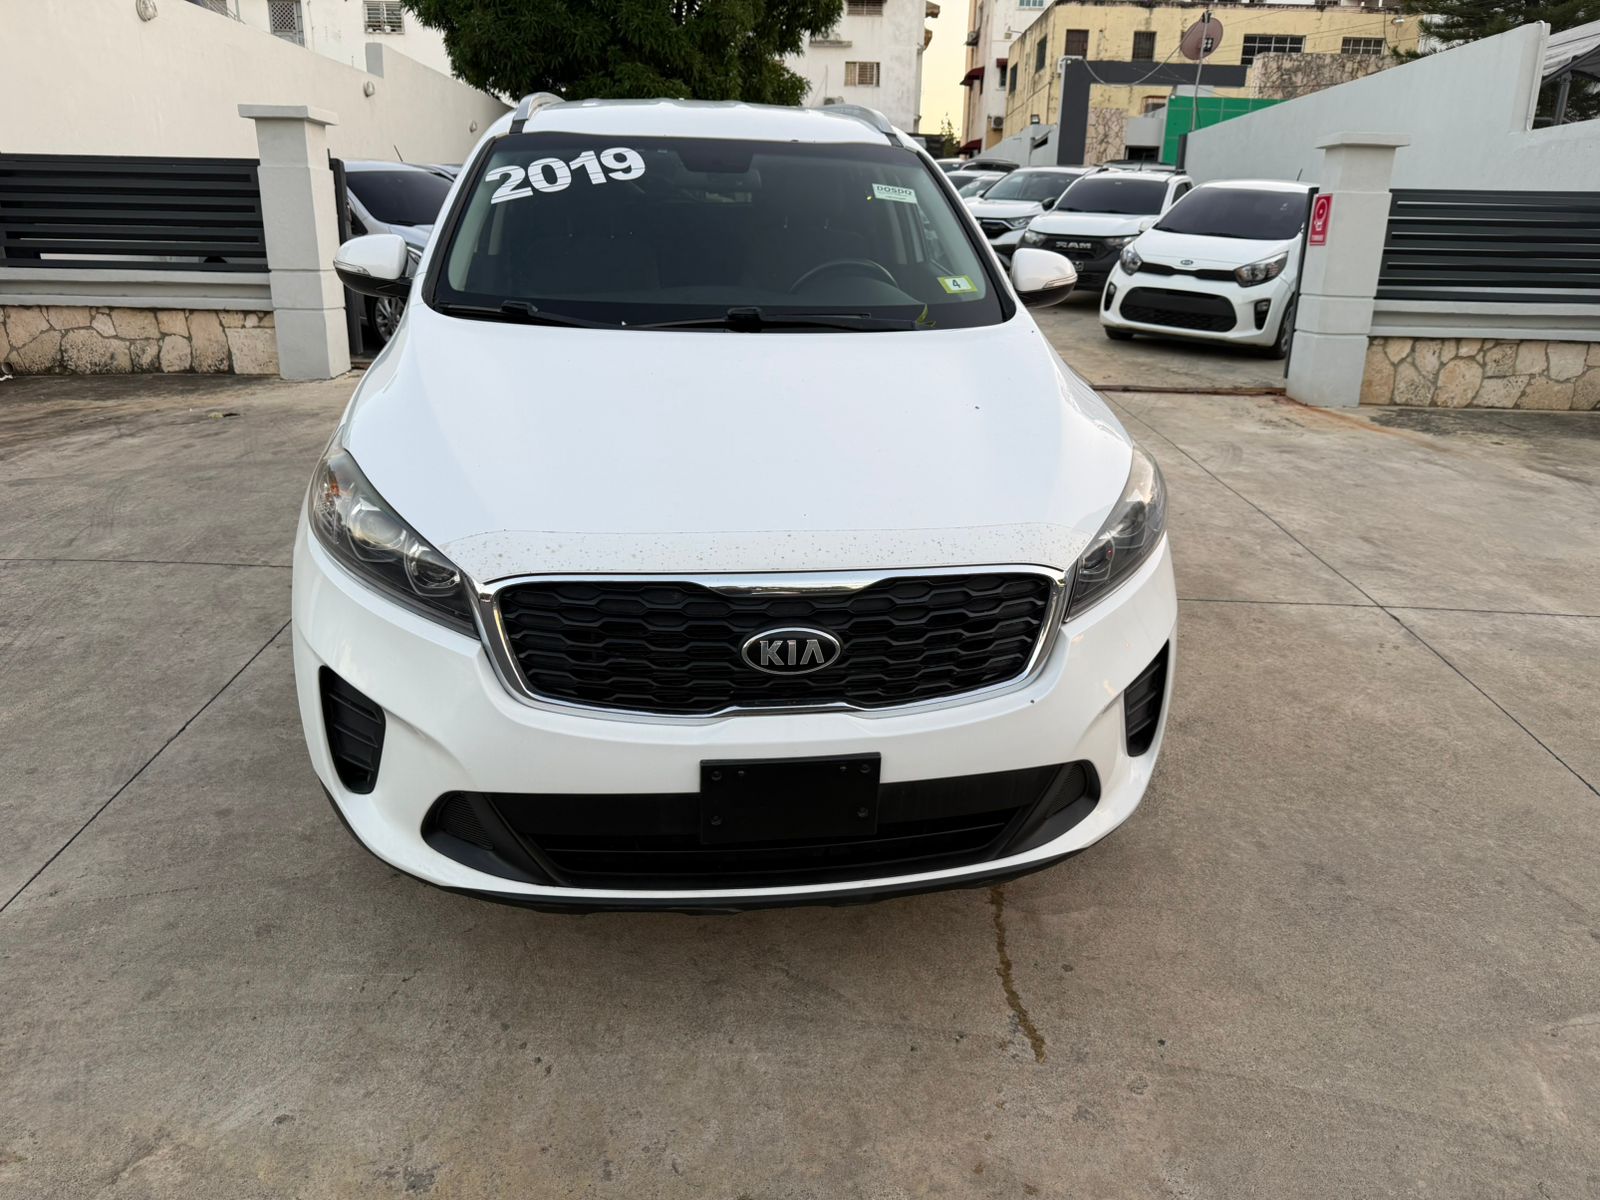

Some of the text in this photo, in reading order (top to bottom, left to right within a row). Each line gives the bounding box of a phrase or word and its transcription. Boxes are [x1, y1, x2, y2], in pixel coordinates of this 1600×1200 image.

[485, 147, 645, 204] 2019
[952, 279, 961, 288] 4
[760, 639, 825, 666] KIA
